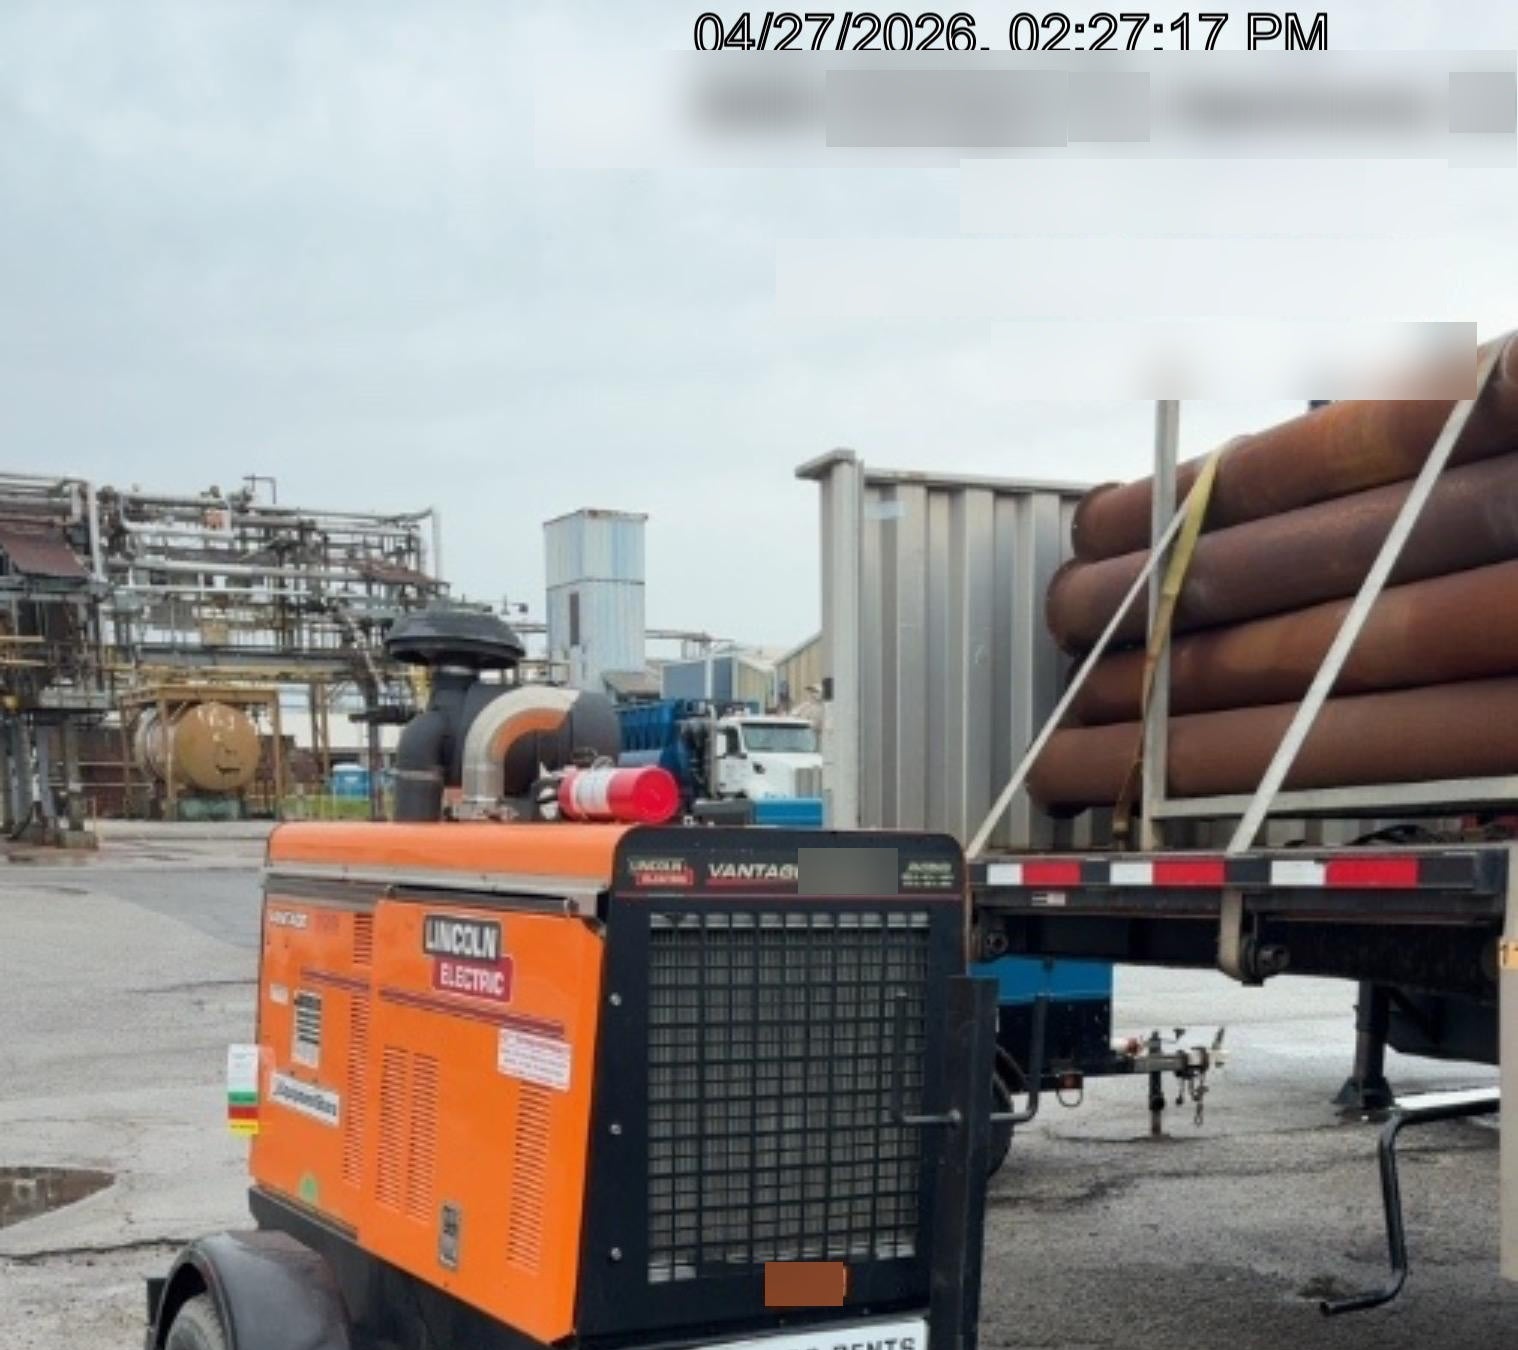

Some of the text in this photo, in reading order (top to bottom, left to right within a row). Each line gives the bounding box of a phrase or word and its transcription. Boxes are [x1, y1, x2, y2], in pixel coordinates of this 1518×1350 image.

[707, 863, 799, 879] VANTAG
[424, 918, 498, 961] LINCOLN
[440, 962, 505, 995] ELECTRIC
